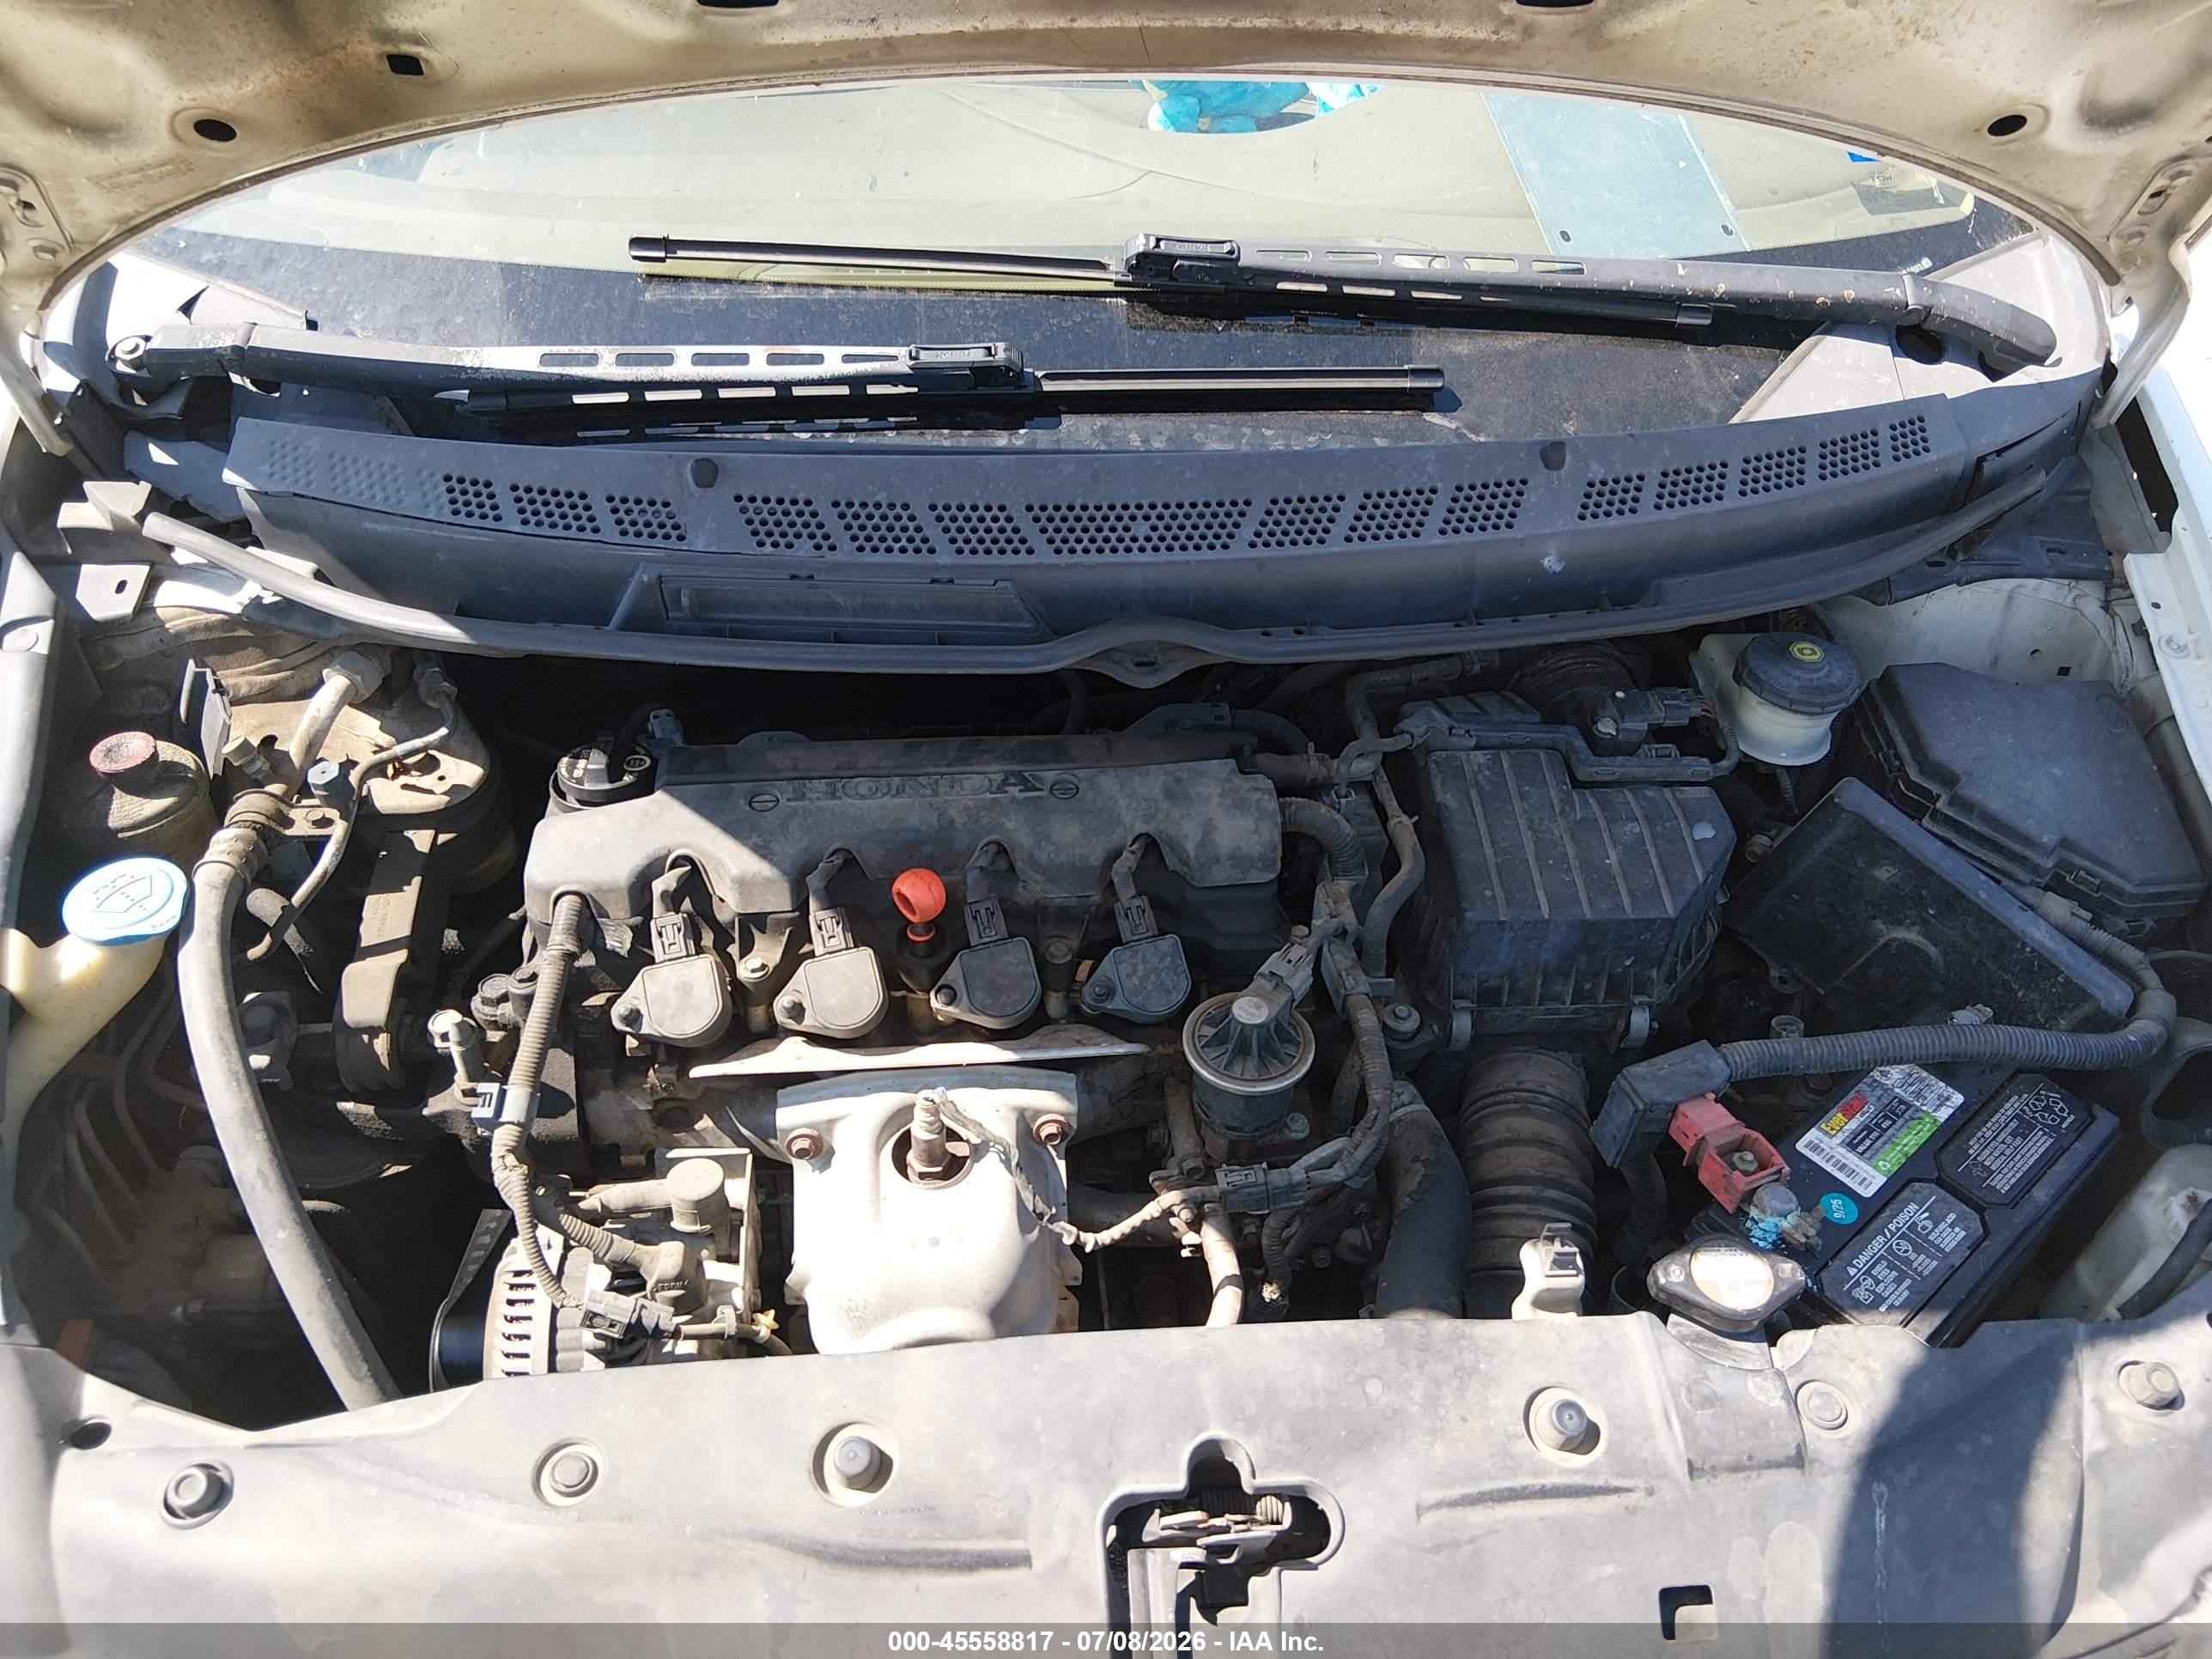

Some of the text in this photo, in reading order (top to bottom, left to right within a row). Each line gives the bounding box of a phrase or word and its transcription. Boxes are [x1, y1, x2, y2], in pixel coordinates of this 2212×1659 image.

[786, 772, 1045, 802] HONDA
[2011, 1136, 2023, 1146] FAST
[1831, 1198, 1845, 1218] 9/25
[1852, 1235, 1887, 1267] DANGER
[1887, 1202, 1918, 1231] POISON
